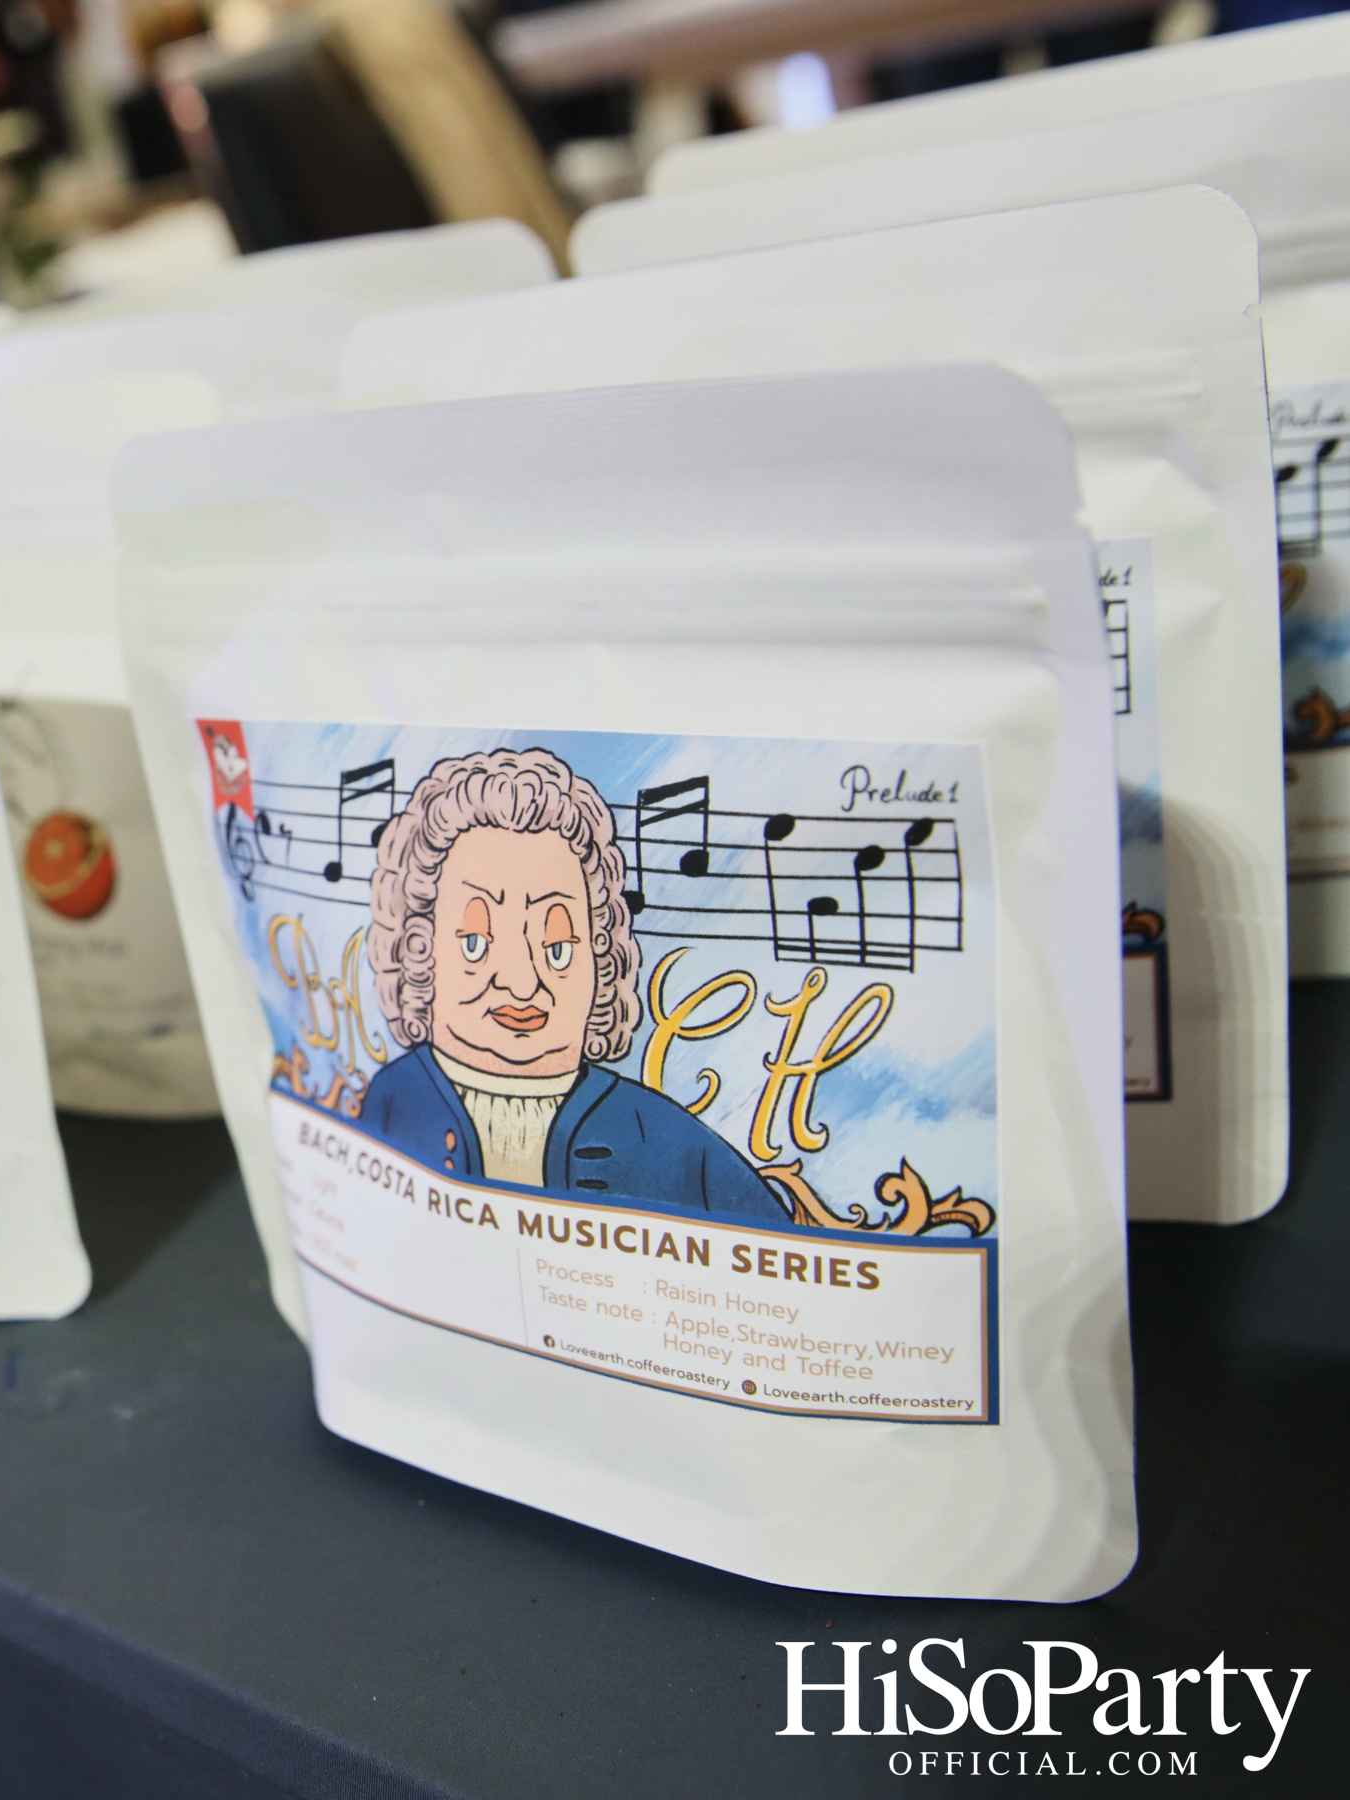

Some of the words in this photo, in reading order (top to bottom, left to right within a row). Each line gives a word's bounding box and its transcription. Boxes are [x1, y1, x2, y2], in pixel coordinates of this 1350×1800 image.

[840, 764, 944, 812] Prelude
[427, 1186, 501, 1230] RICA
[517, 1209, 711, 1268] MUSICIAN
[731, 1243, 881, 1291] SERIES
[536, 1257, 615, 1289] Process
[655, 1278, 717, 1308] Raisin
[725, 1292, 801, 1324] Honey
[538, 1284, 588, 1312] Taste
[595, 1300, 644, 1323] note
[559, 1338, 732, 1391] Loveearth.coffeeroastery
[763, 1383, 975, 1411] Loveearth.coffeeroastery
[662, 1332, 734, 1366] Honey
[742, 1352, 787, 1373] and
[796, 1355, 875, 1381] Toffee
